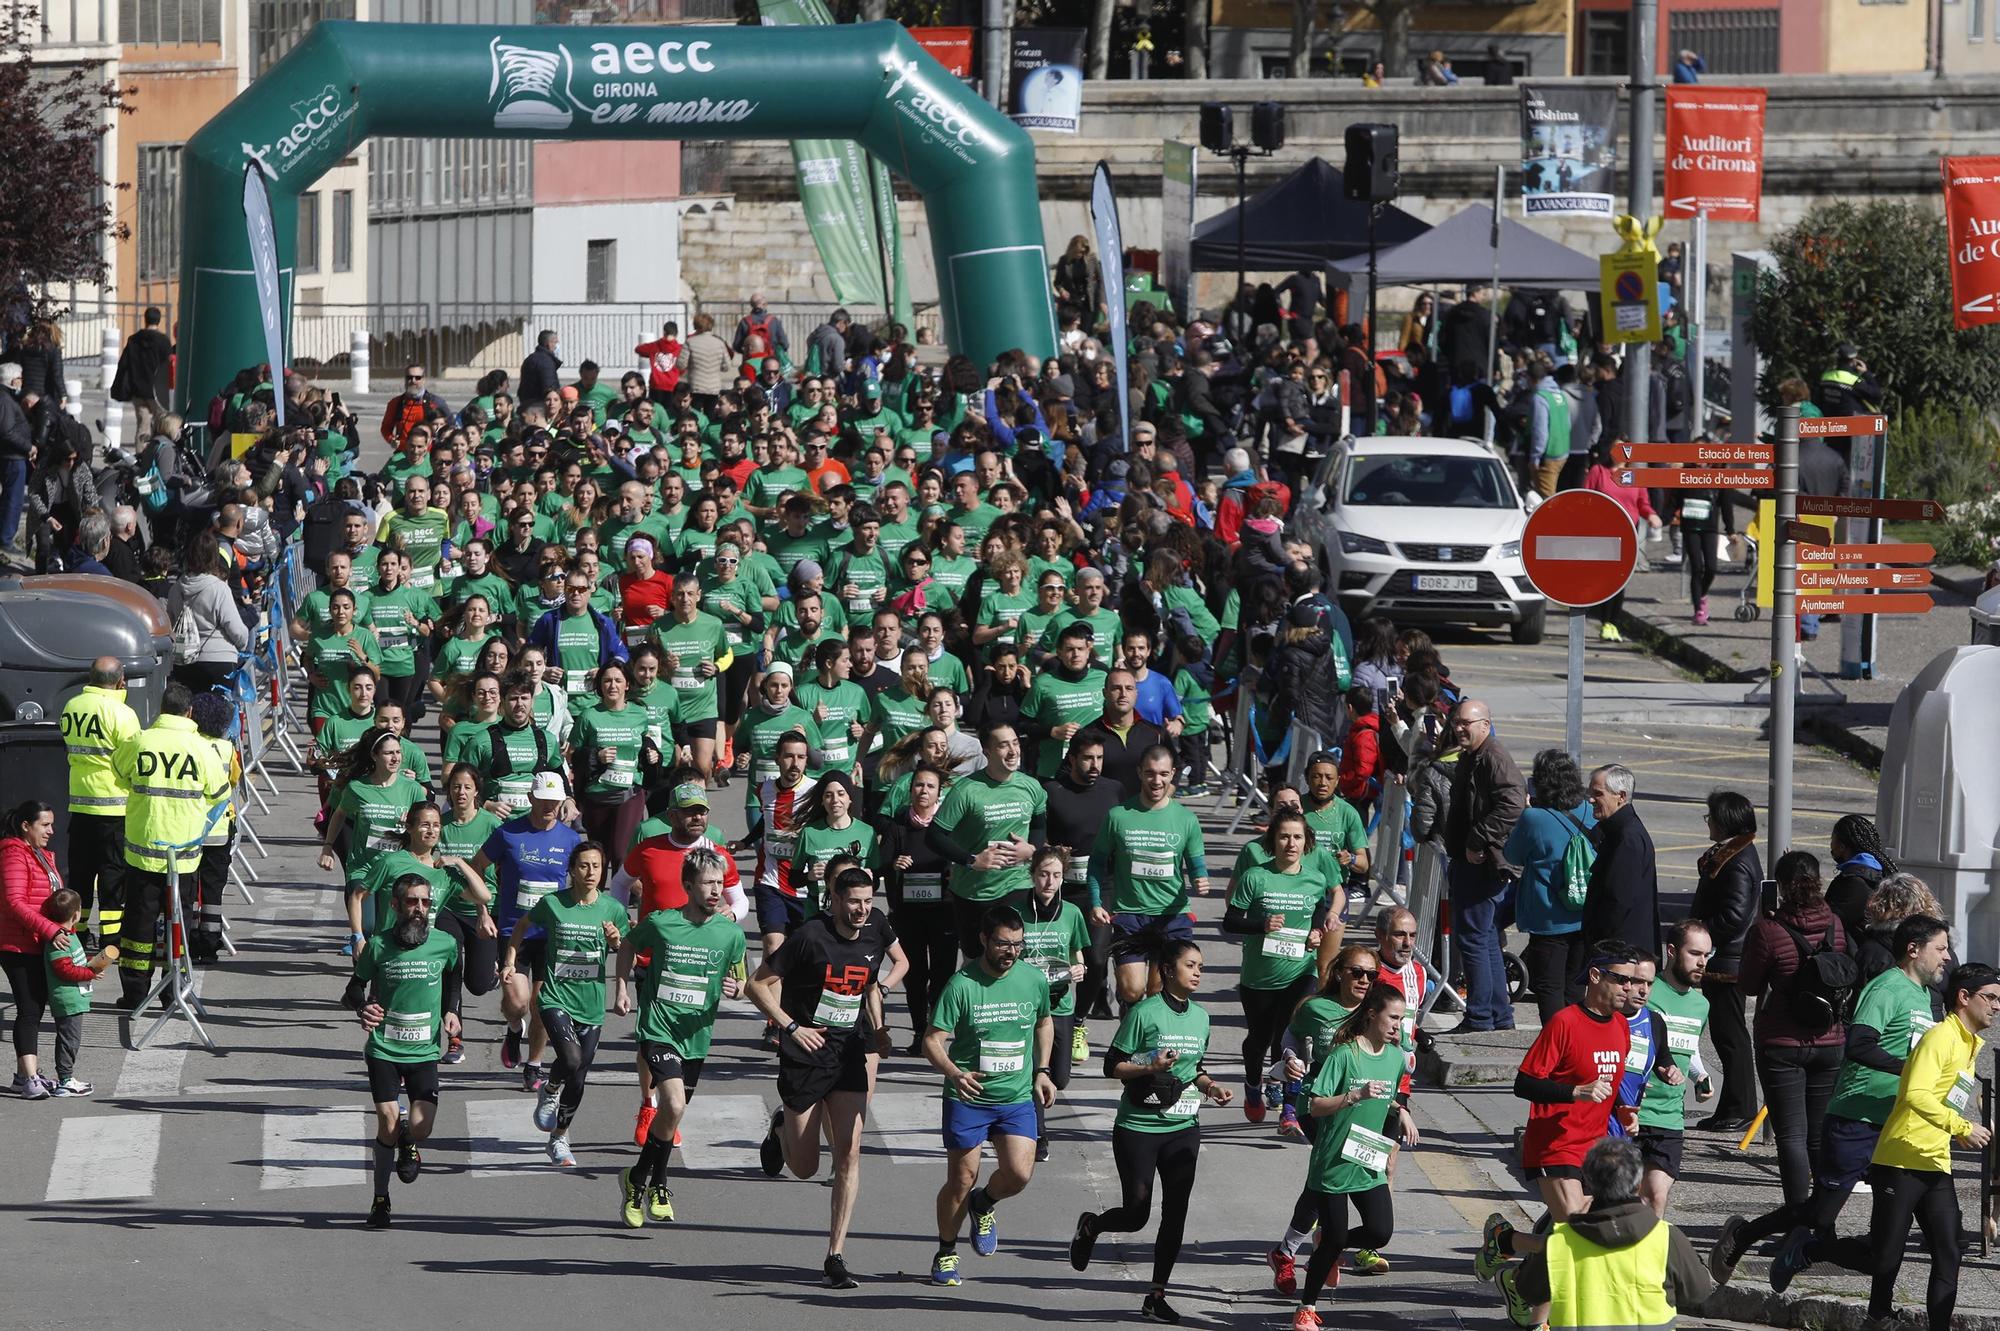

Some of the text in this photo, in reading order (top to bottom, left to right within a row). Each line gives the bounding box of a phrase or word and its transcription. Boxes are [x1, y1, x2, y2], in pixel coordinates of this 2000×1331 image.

[590, 40, 716, 75] aecc
[593, 81, 659, 98] GIRONA
[591, 97, 760, 123] en marxa
[894, 100, 926, 128] Catalunya
[1528, 109, 1580, 121] Mishima
[911, 91, 984, 146] aecc
[276, 95, 340, 157] aecc
[1683, 135, 1752, 153] Auditori
[1672, 153, 1757, 173] de Girona
[1953, 177, 1984, 186] HIVERN
[1958, 243, 1985, 265] de
[1799, 422, 1848, 434] Oficina de Turisme
[1698, 447, 1770, 460] Estació de trens
[1680, 472, 1769, 485] Estació d'autobusos
[1802, 500, 1873, 514] Muralla medieval
[1801, 548, 1836, 561] Catedral
[1420, 577, 1475, 589] 6082 JYC
[1801, 573, 1869, 588] Call jueu/Museus
[1801, 599, 1845, 613] Ajuntament
[137, 751, 198, 782] DYA
[608, 774, 627, 782] 1493
[772, 846, 795, 856] 1611
[1142, 867, 1165, 876] 1640
[912, 890, 932, 898] 1606
[1275, 945, 1297, 956] 1478
[566, 968, 590, 978] 1629
[669, 991, 694, 1003] 1570
[828, 1011, 850, 1022] 1473
[395, 1031, 421, 1041] 1403
[1670, 1036, 1690, 1048] 1601
[1593, 1050, 1620, 1064] run
[991, 1061, 1016, 1072] 1568
[1597, 1063, 1617, 1073] run
[1173, 1104, 1193, 1114] 1471
[1357, 1142, 1378, 1155] CRISTINA
[1354, 1149, 1377, 1164] 1401
